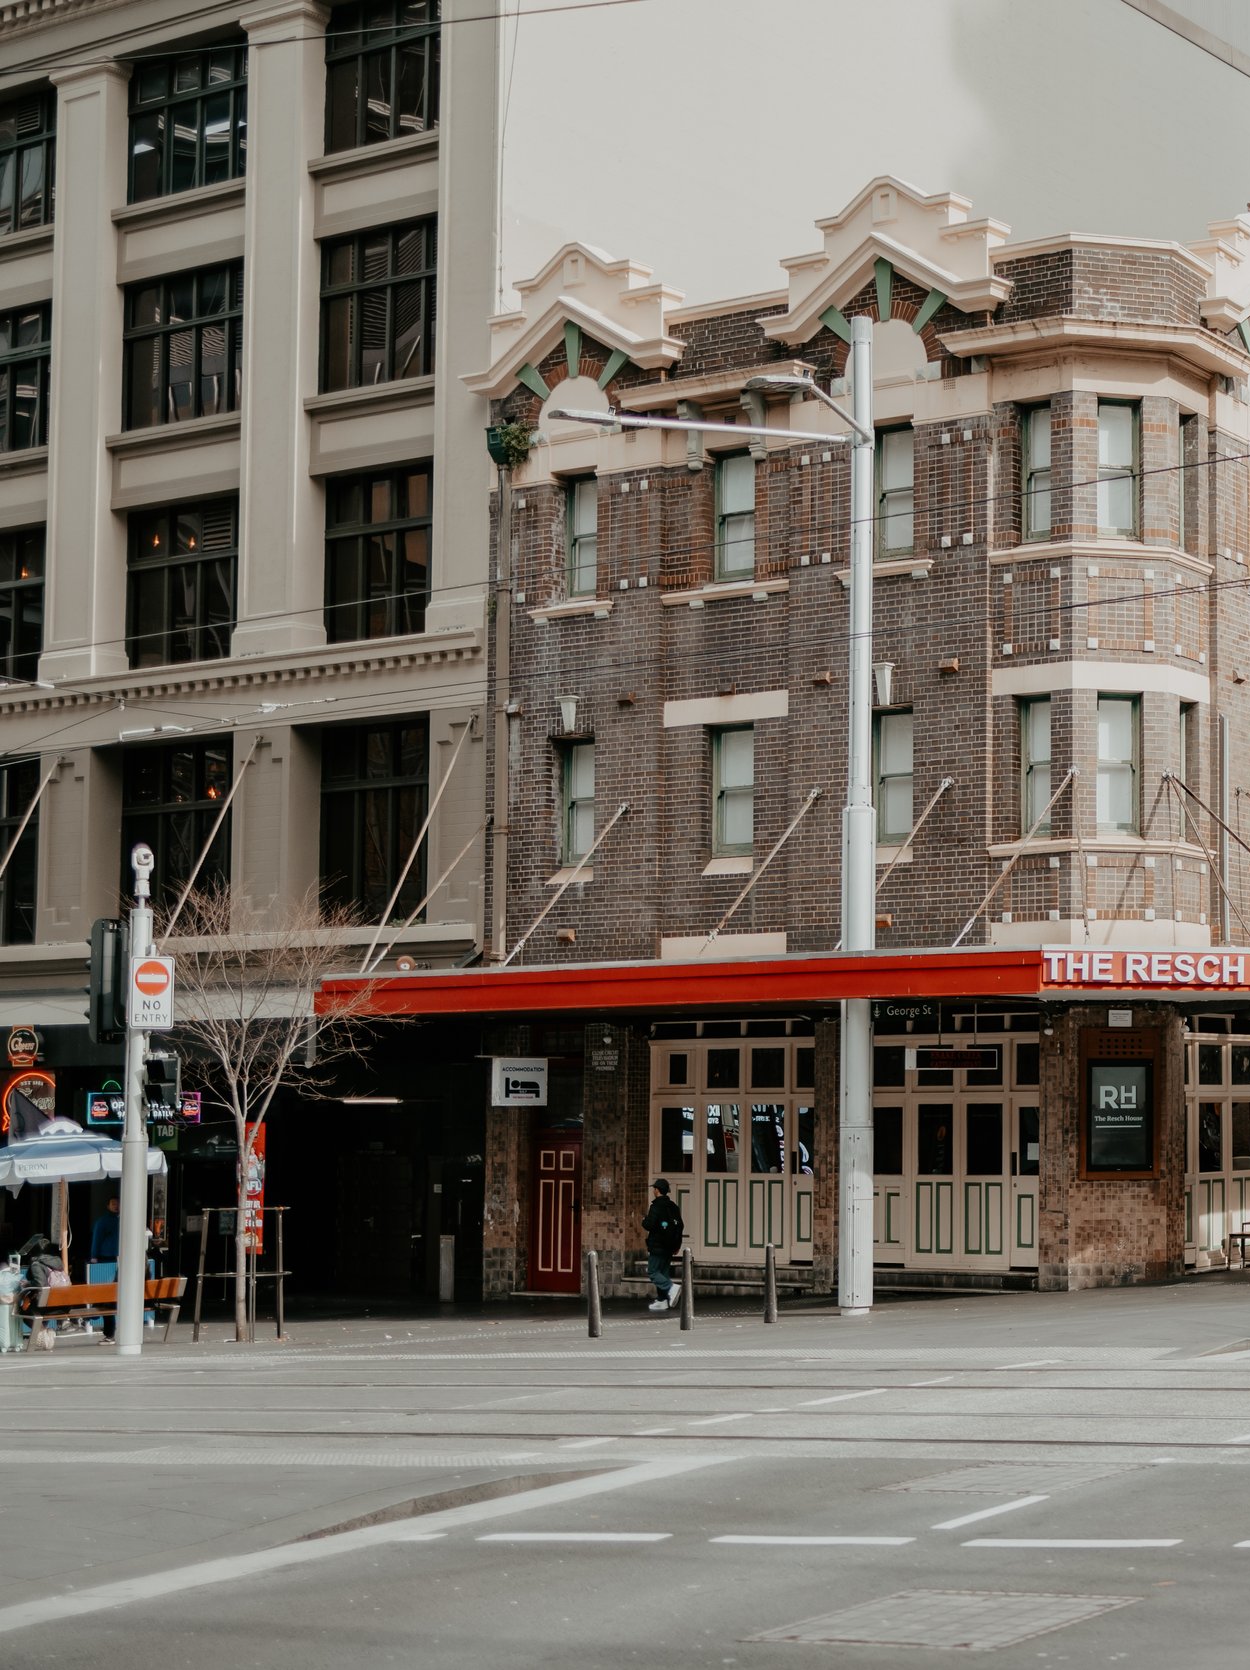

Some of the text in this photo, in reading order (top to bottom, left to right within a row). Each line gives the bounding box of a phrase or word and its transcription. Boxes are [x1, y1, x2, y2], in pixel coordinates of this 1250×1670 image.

[1044, 952, 1113, 981] THE
[1126, 953, 1245, 983] RESCH
[142, 1001, 161, 1010] NO
[886, 1004, 932, 1018] George St
[134, 1014, 168, 1022] ENTRY
[1099, 1085, 1137, 1109] RH
[157, 1125, 174, 1136] TAB
